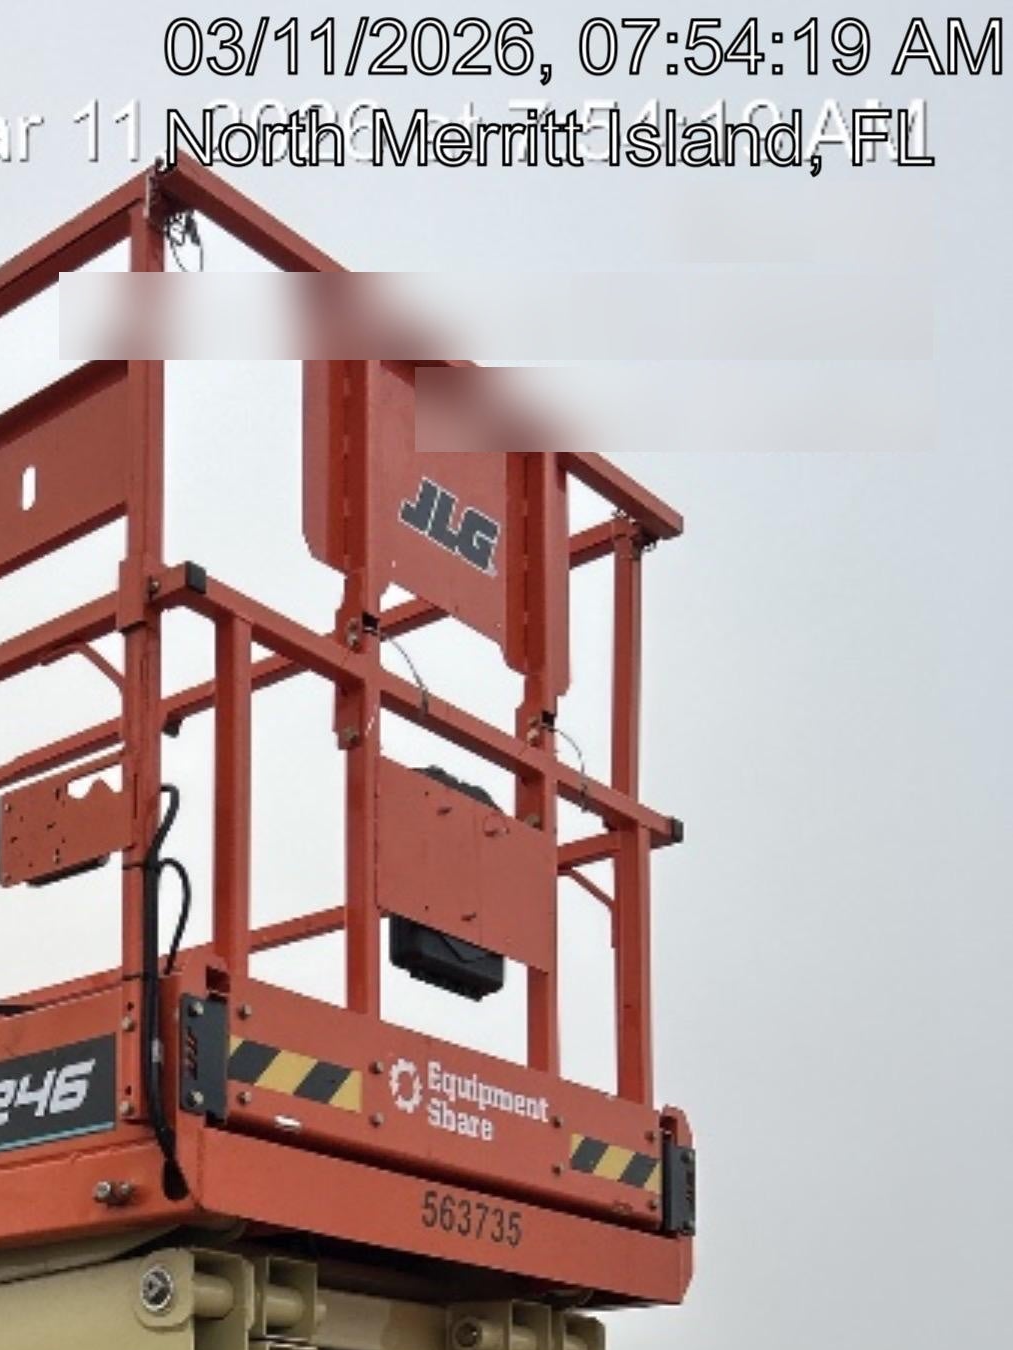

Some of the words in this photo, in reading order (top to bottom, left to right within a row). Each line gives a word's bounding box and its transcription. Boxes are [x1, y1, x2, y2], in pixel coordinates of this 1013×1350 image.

[399, 477, 499, 575] JLG
[427, 1062, 549, 1122] Equipment
[427, 1099, 493, 1140] Share
[422, 1192, 522, 1247] 563735
